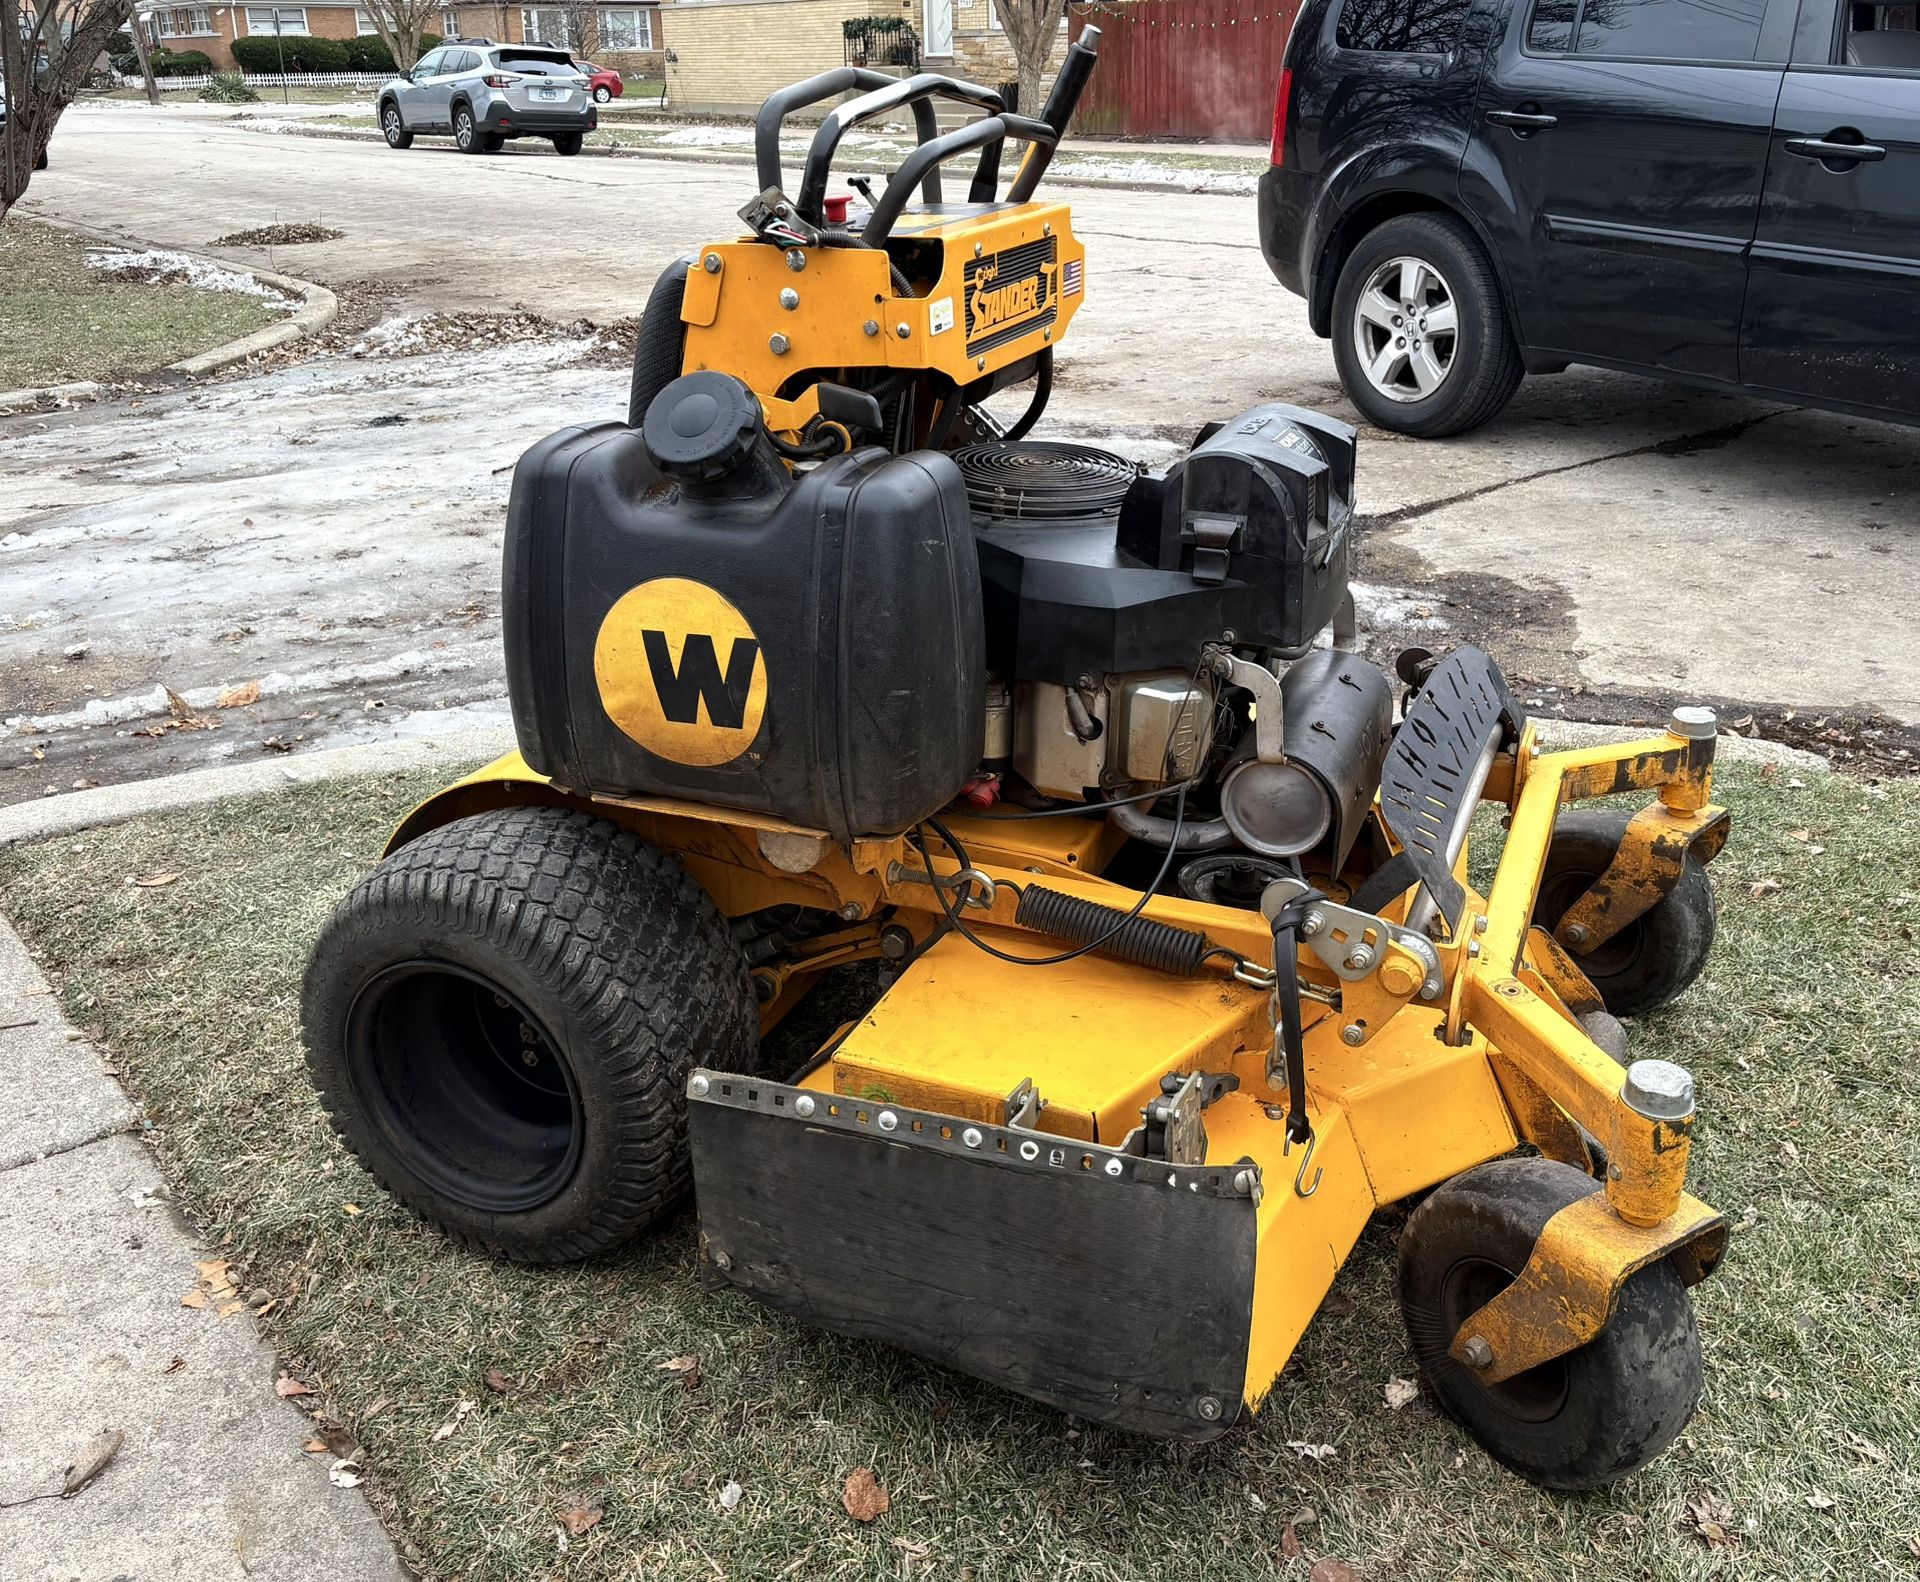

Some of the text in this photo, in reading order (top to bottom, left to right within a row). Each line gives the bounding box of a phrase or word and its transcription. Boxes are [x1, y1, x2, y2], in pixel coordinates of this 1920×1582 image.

[970, 276, 1039, 332] STANDER
[641, 629, 760, 730] W
[748, 751, 760, 760] TM
[1396, 689, 1450, 778] HOT
